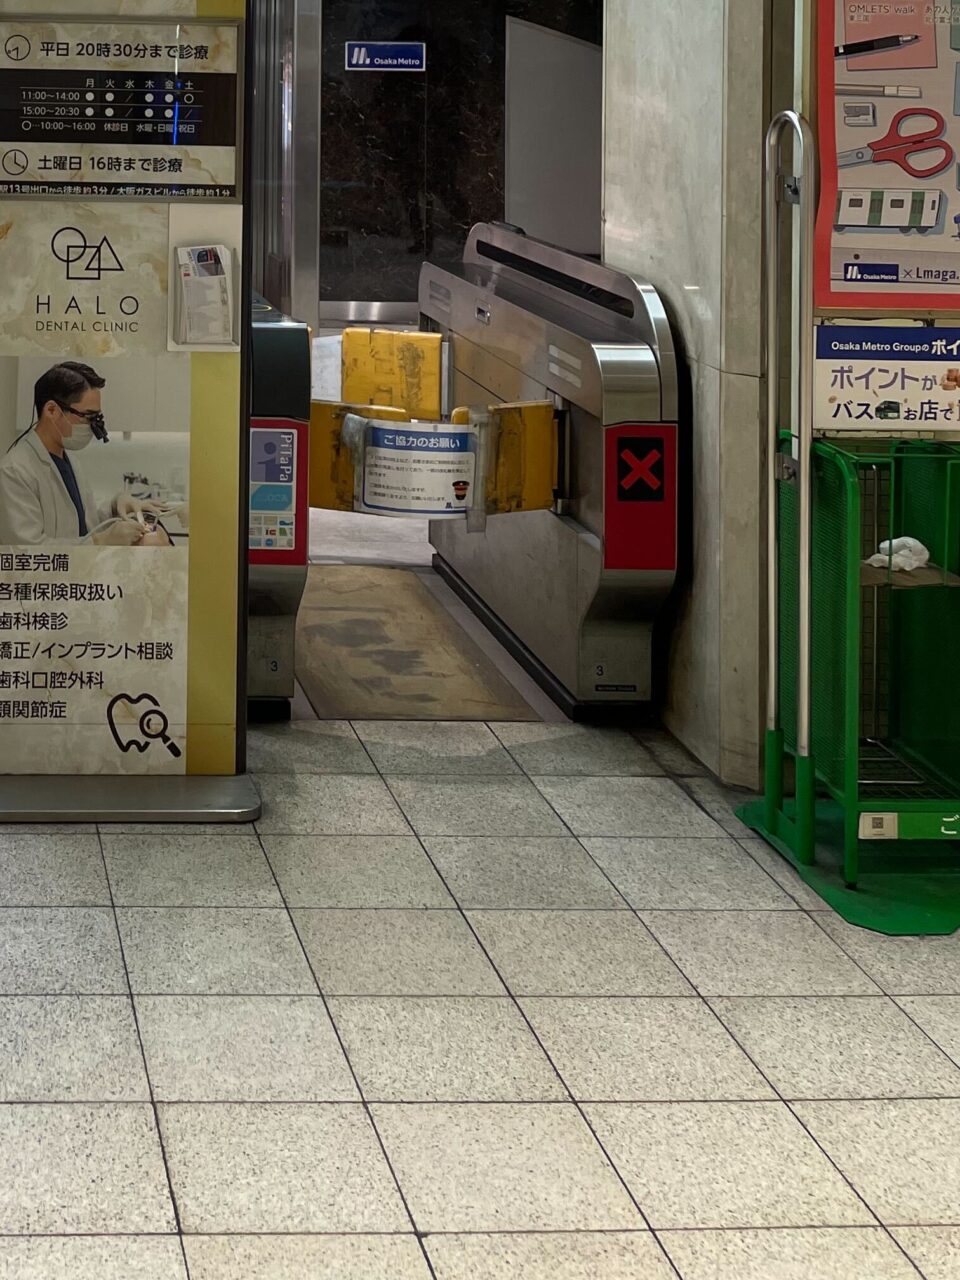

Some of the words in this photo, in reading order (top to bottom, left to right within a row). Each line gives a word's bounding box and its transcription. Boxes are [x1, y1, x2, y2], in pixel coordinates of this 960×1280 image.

[40, 41, 69, 57] 平日
[76, 42, 209, 60] 20時30分まで診療
[374, 57, 397, 65] Osaka
[85, 79, 94, 87] 月
[105, 79, 115, 88] 火
[125, 79, 135, 88] 水
[145, 80, 154, 89] 木
[164, 80, 174, 89] 金
[184, 81, 194, 90] 土
[38, 155, 82, 171] 土曜日
[89, 156, 182, 173] 16時まで診療
[36, 294, 139, 316] HALO
[35, 320, 87, 332] DENTAL
[92, 321, 139, 333] CLINIC
[831, 341, 860, 351] Osaka
[862, 342, 891, 351] Metro
[830, 365, 938, 390] ポイントが
[831, 400, 874, 420] バス
[903, 399, 960, 421] お店で
[383, 434, 460, 449] ご協力のお願い
[279, 434, 293, 482] PiTaPa
[596, 665, 604, 676] 3
